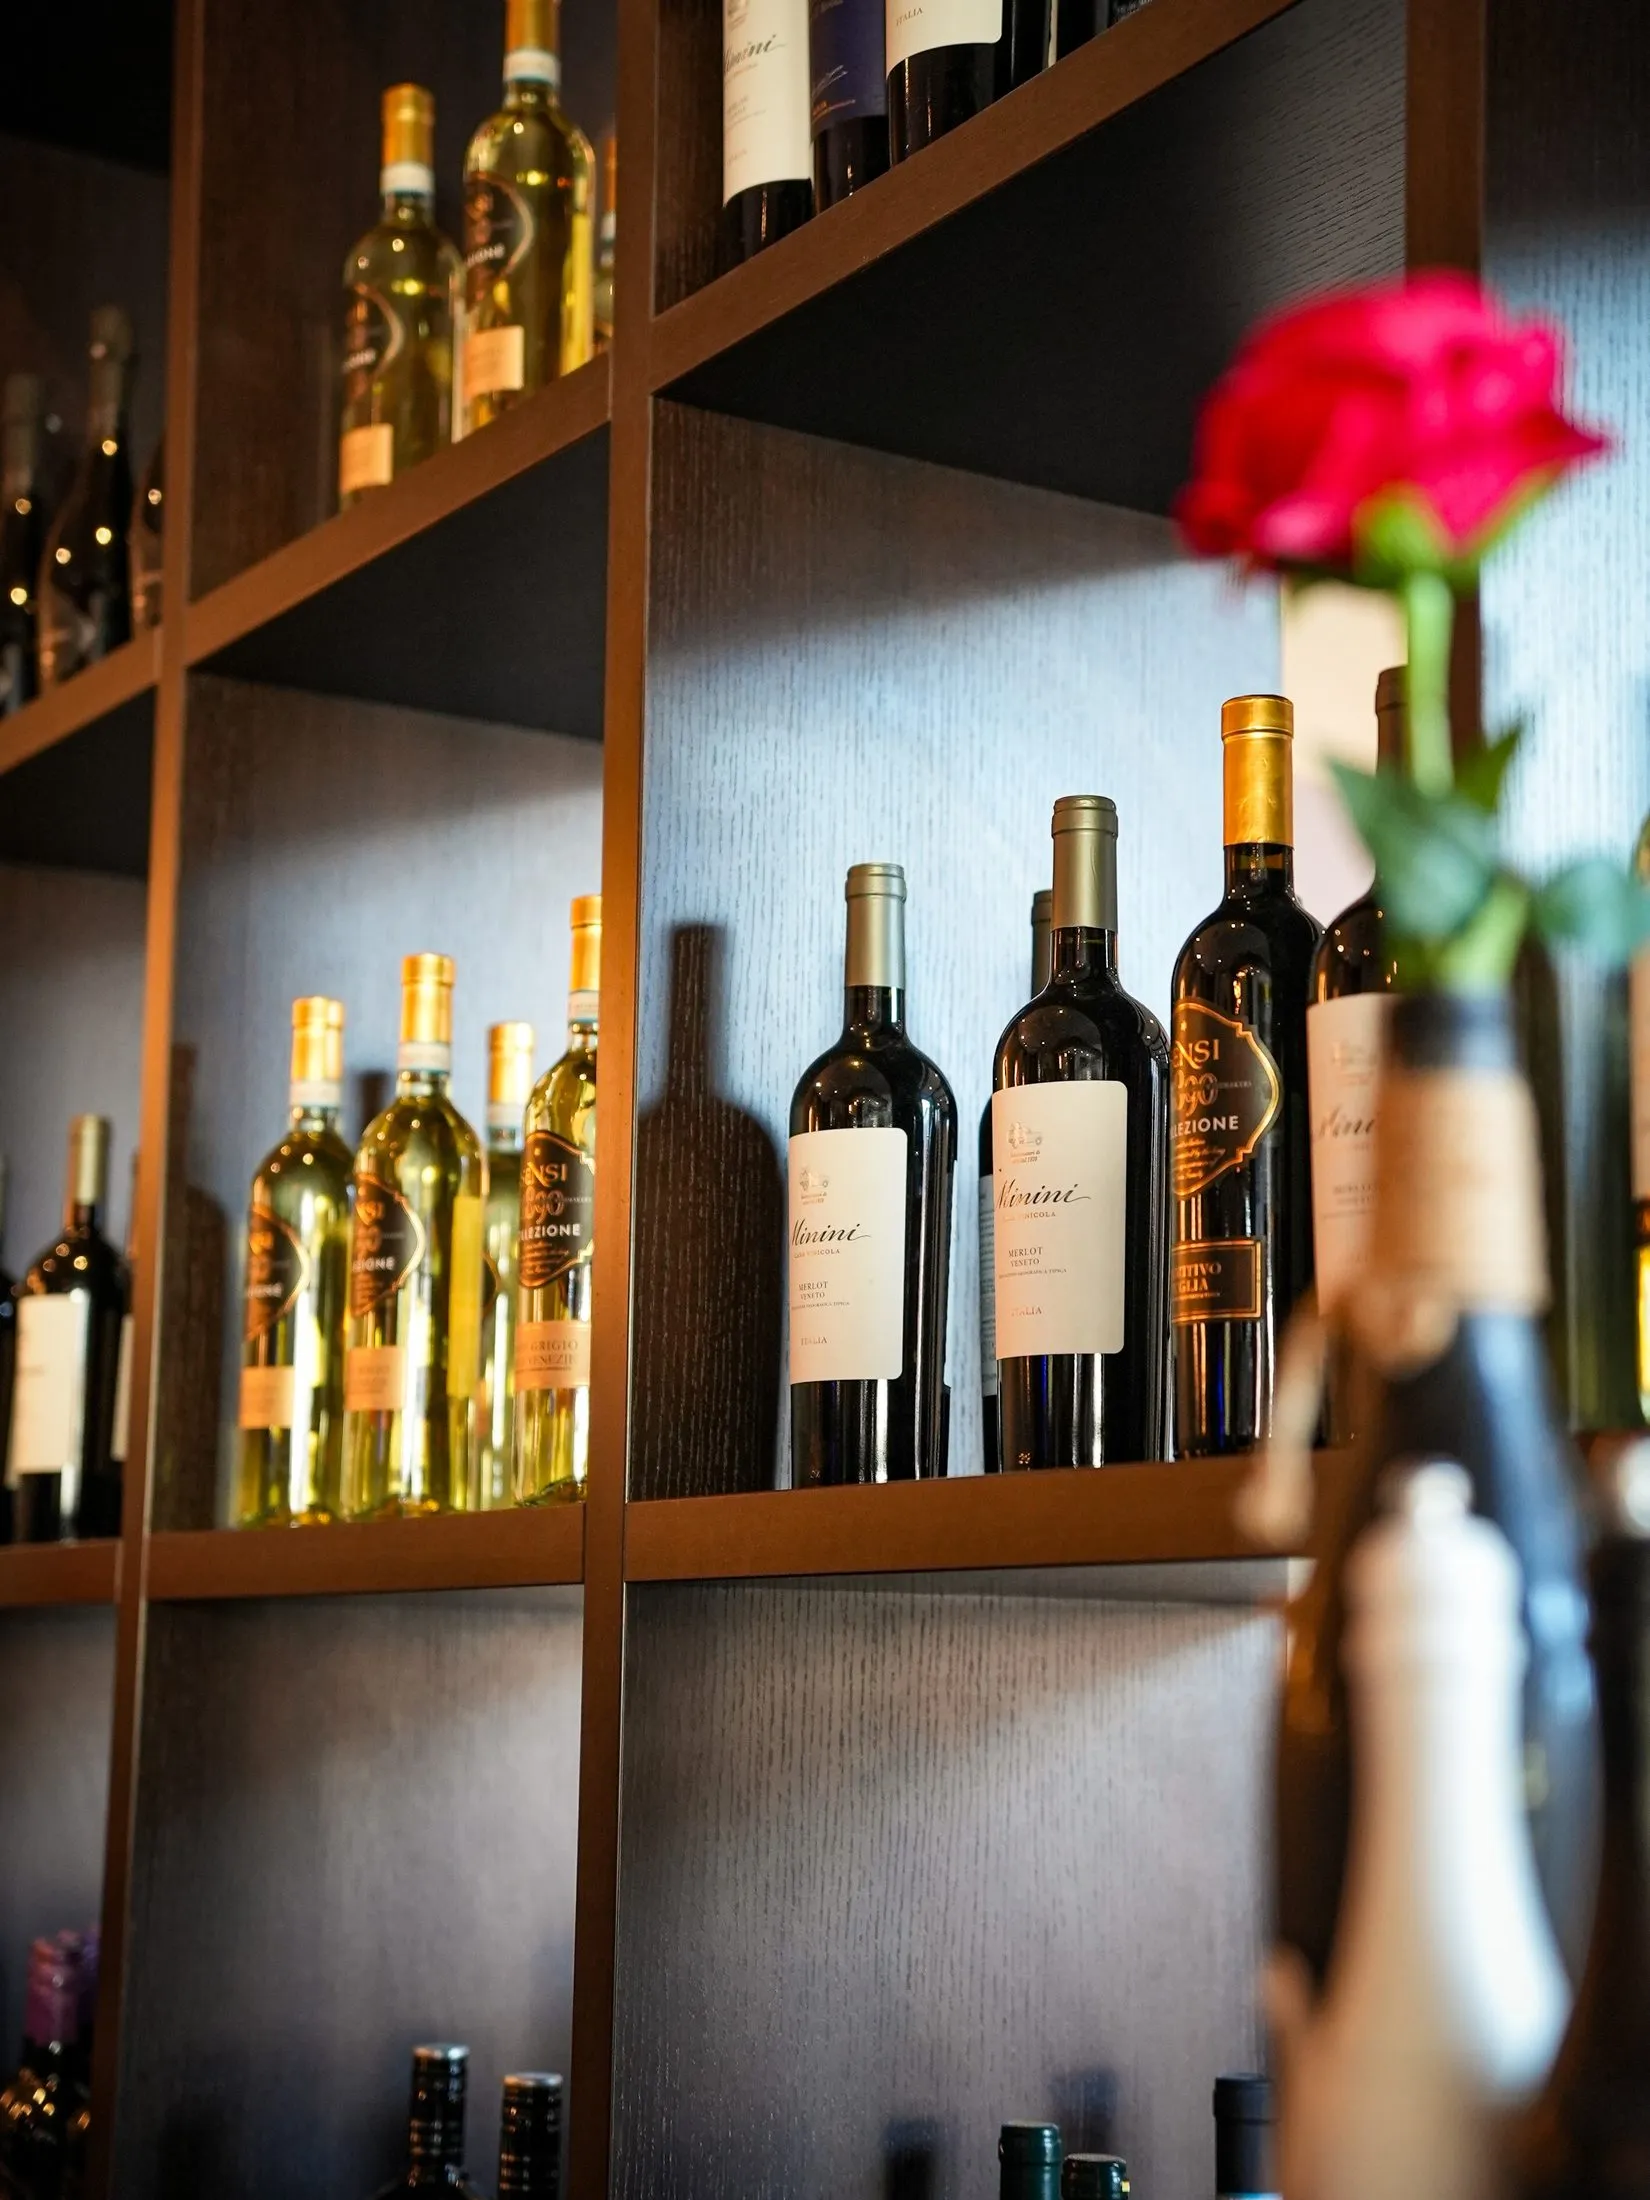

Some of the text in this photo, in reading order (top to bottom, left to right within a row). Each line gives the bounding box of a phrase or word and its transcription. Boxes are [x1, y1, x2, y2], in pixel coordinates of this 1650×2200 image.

[1172, 1039, 1220, 1070] ENSI
[1008, 1246, 1043, 1258] MERLOT
[798, 1281, 828, 1291] MERLOT
